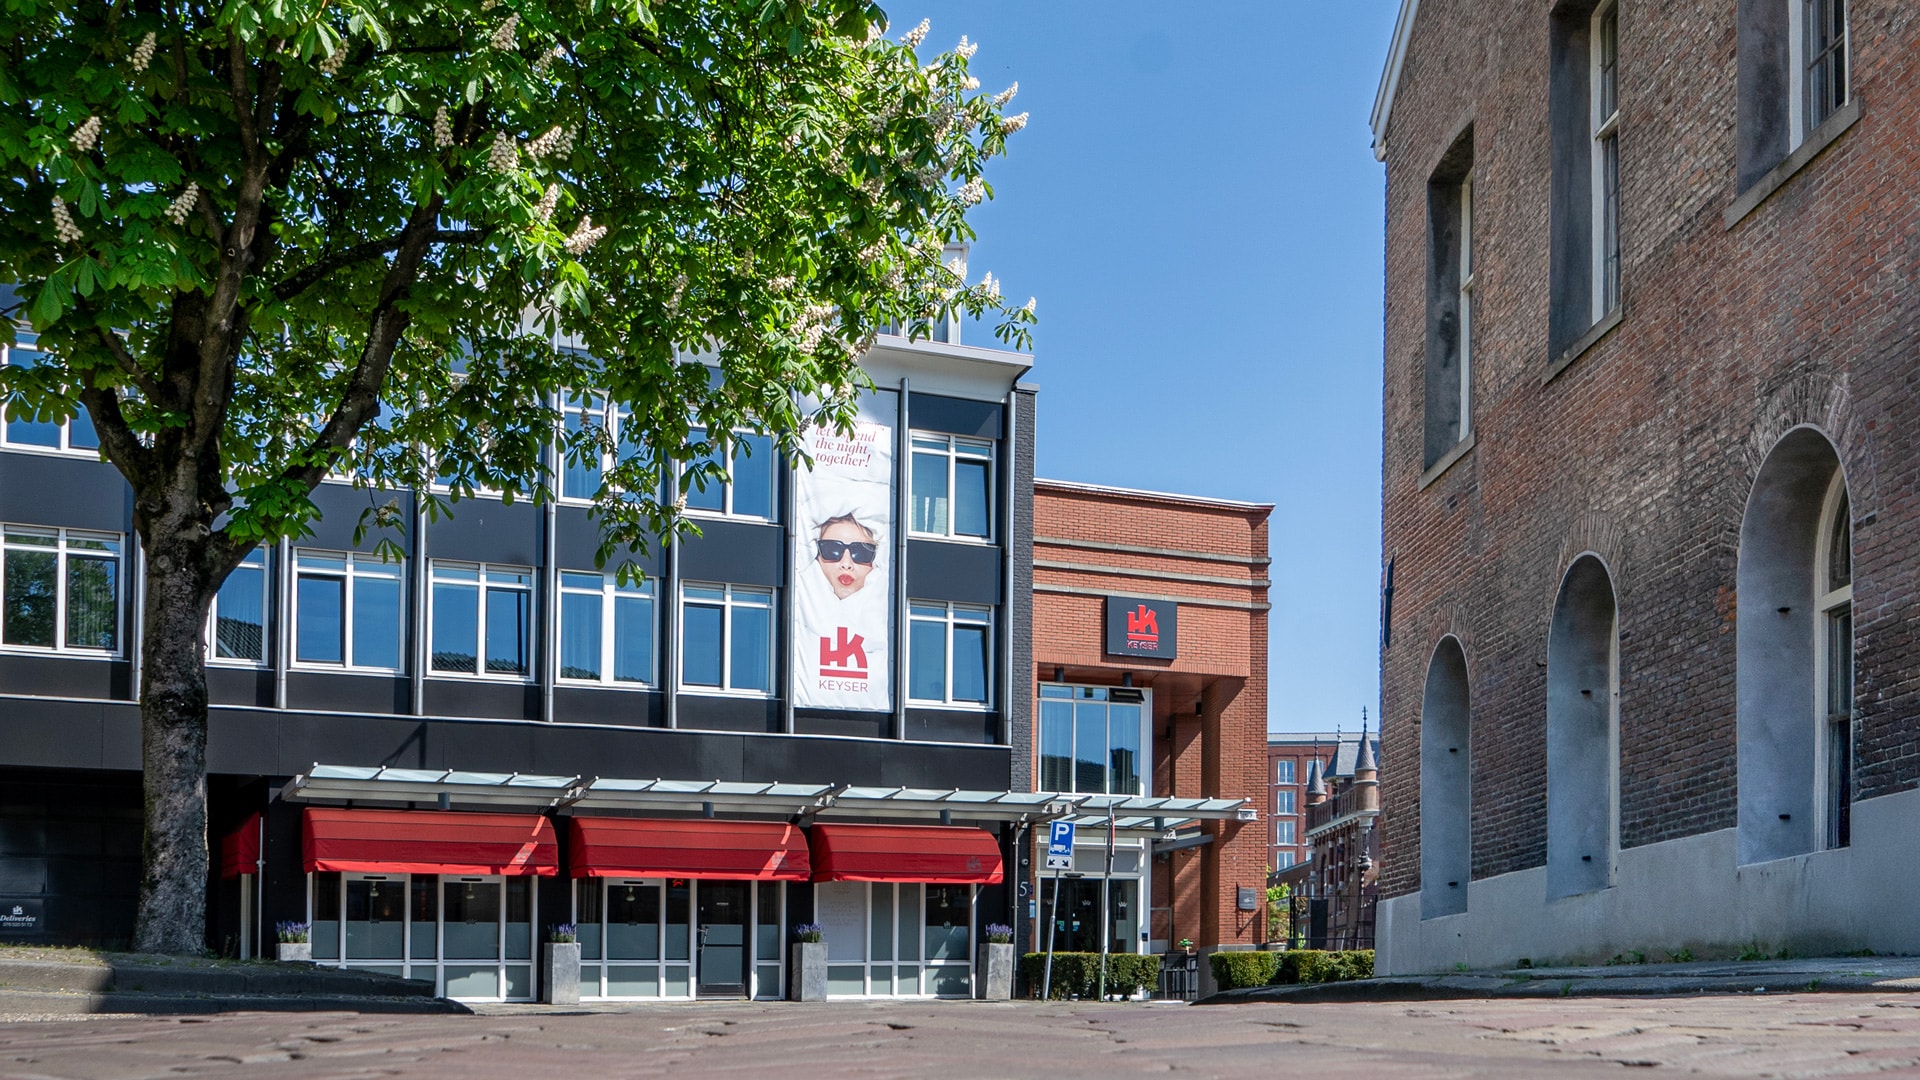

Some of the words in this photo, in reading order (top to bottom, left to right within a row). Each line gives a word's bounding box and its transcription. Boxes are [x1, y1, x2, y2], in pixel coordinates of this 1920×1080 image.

[815, 423, 836, 437] lets
[815, 437, 834, 450] the
[836, 442, 867, 455] night
[815, 452, 871, 468] together!
[1127, 640, 1159, 650] KEYSER
[819, 680, 868, 692] KEYSER
[1055, 824, 1069, 840] P
[1019, 881, 1028, 896] 5
